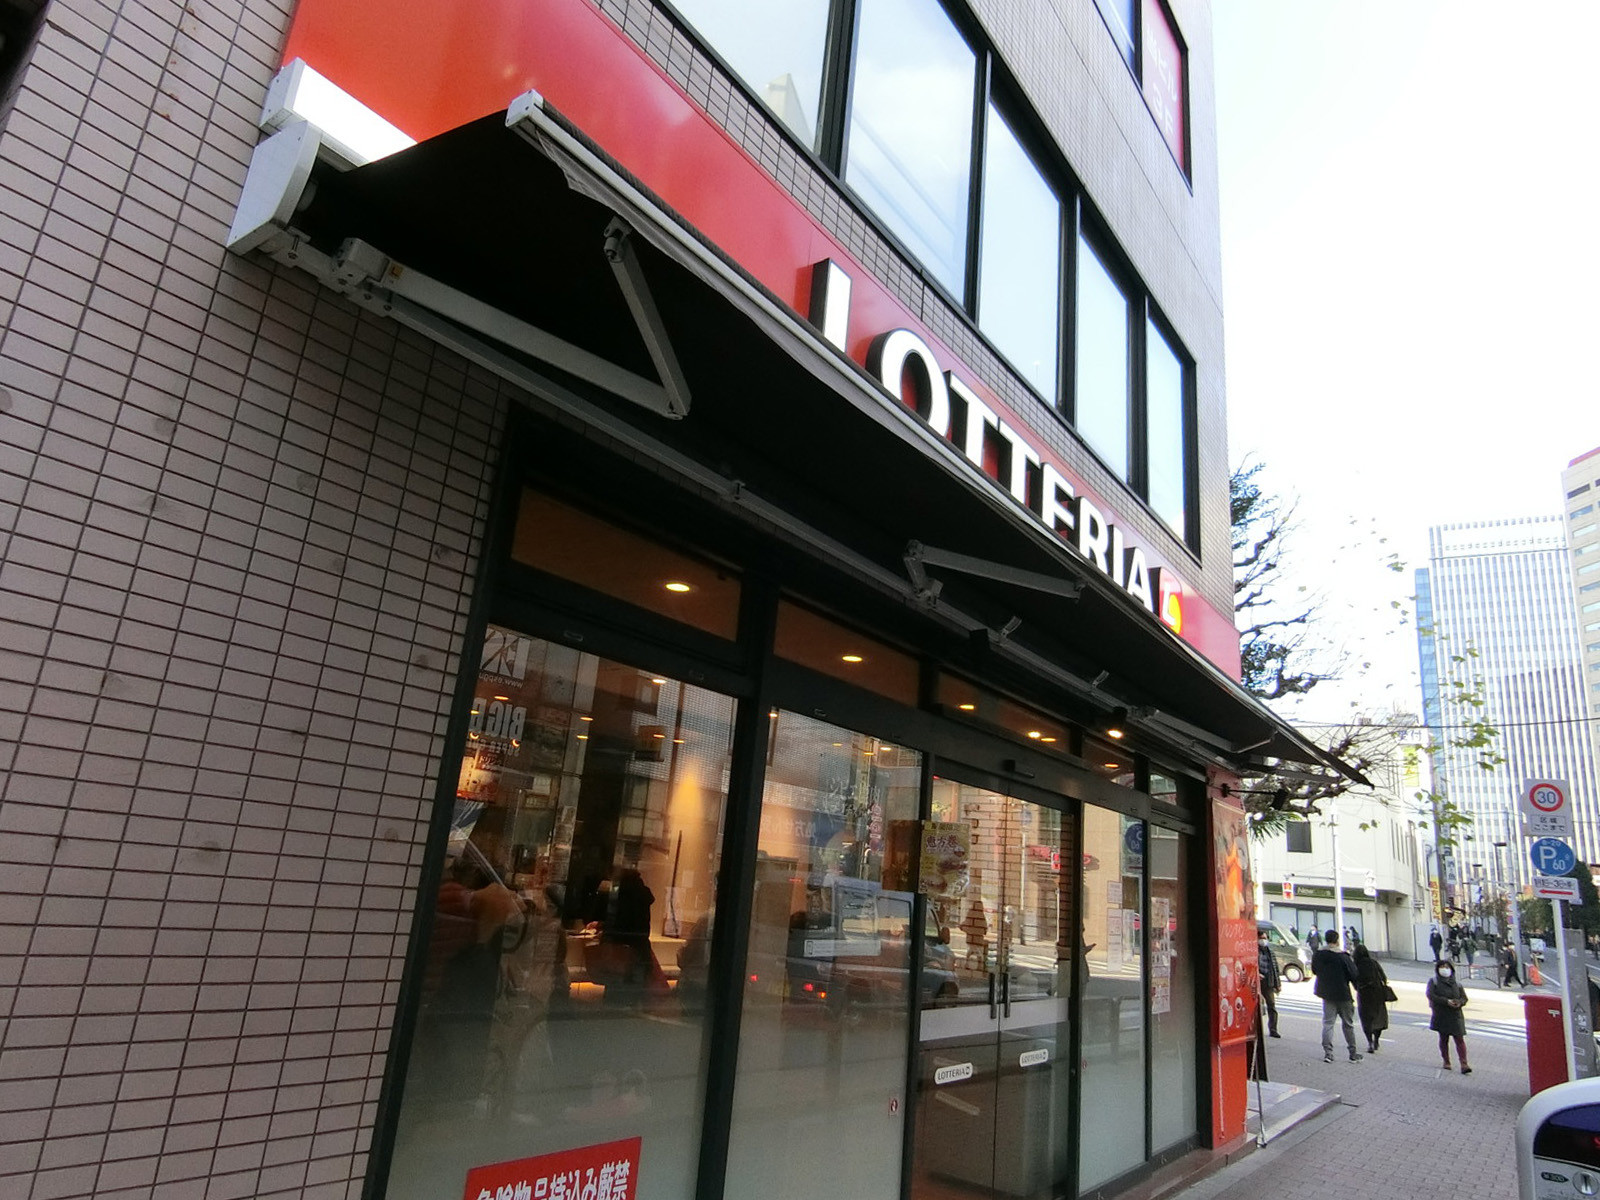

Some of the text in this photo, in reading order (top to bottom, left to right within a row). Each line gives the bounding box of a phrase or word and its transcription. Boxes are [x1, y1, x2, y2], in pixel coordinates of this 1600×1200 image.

[816, 258, 1155, 614] LOTTERIA
[1537, 790, 1556, 804] 30
[1539, 846, 1557, 869] P
[937, 1068, 966, 1081] LOTTERIA
